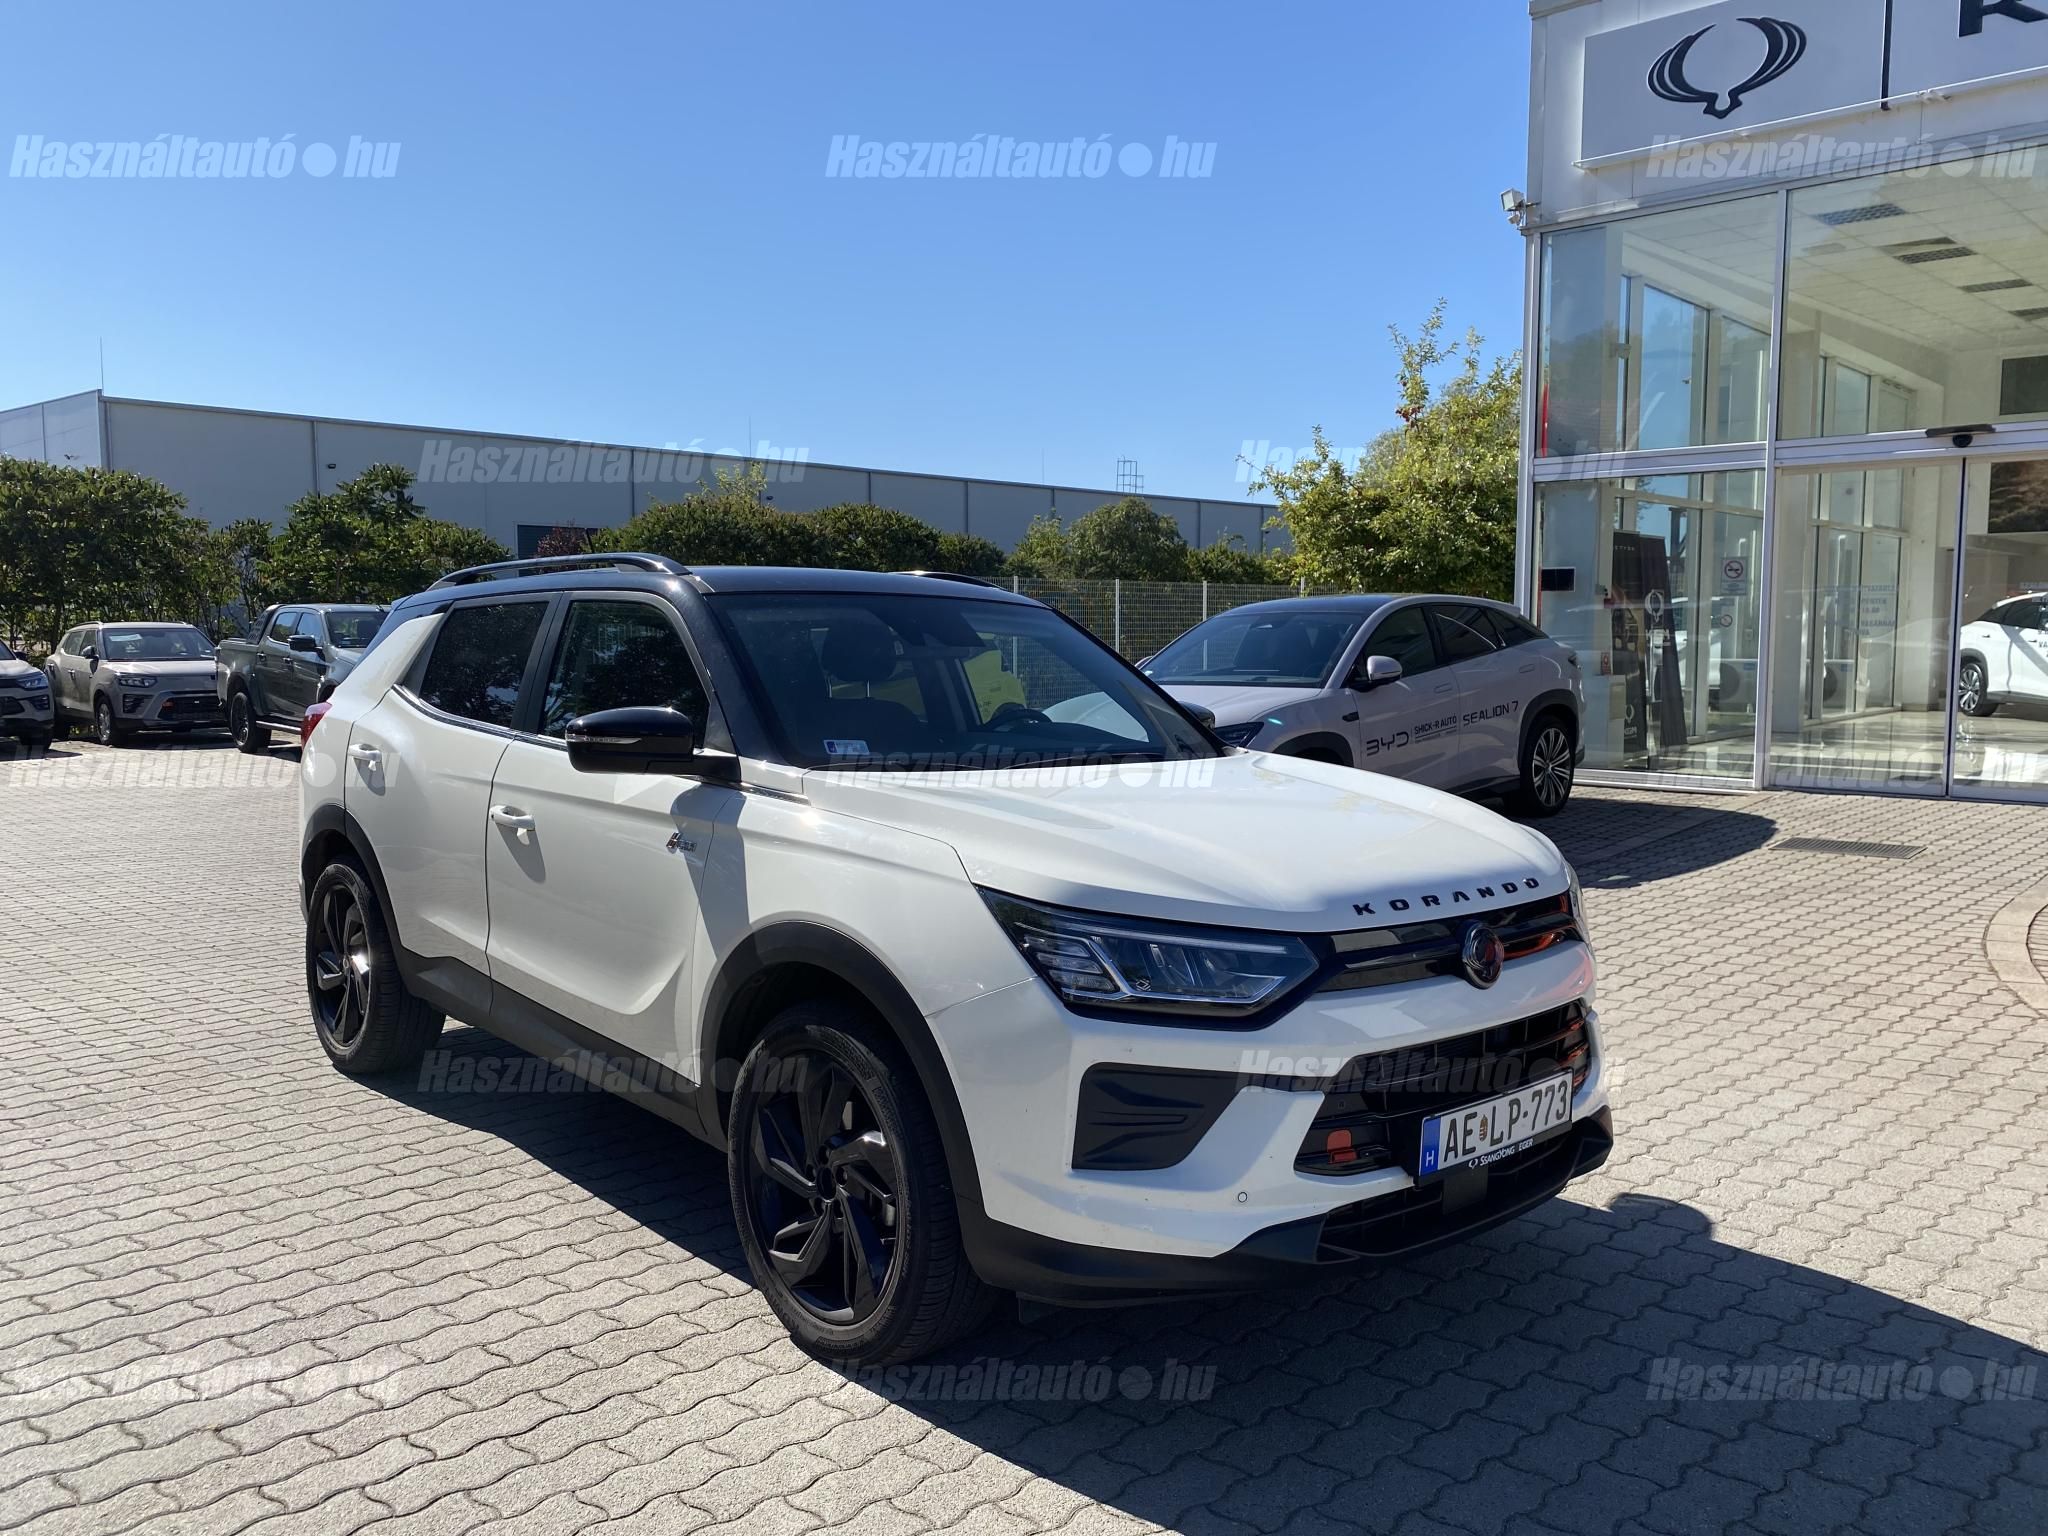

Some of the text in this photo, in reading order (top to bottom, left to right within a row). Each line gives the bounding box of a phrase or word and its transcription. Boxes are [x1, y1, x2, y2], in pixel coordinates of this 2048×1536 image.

[1462, 701, 1519, 727] SEALION 7
[1366, 731, 1410, 757] BYD
[1353, 877, 1540, 916] KORANDO
[1444, 1111, 1478, 1163] AE
[1518, 1138, 1534, 1151] EGER
[1425, 1150, 1435, 1167] H
